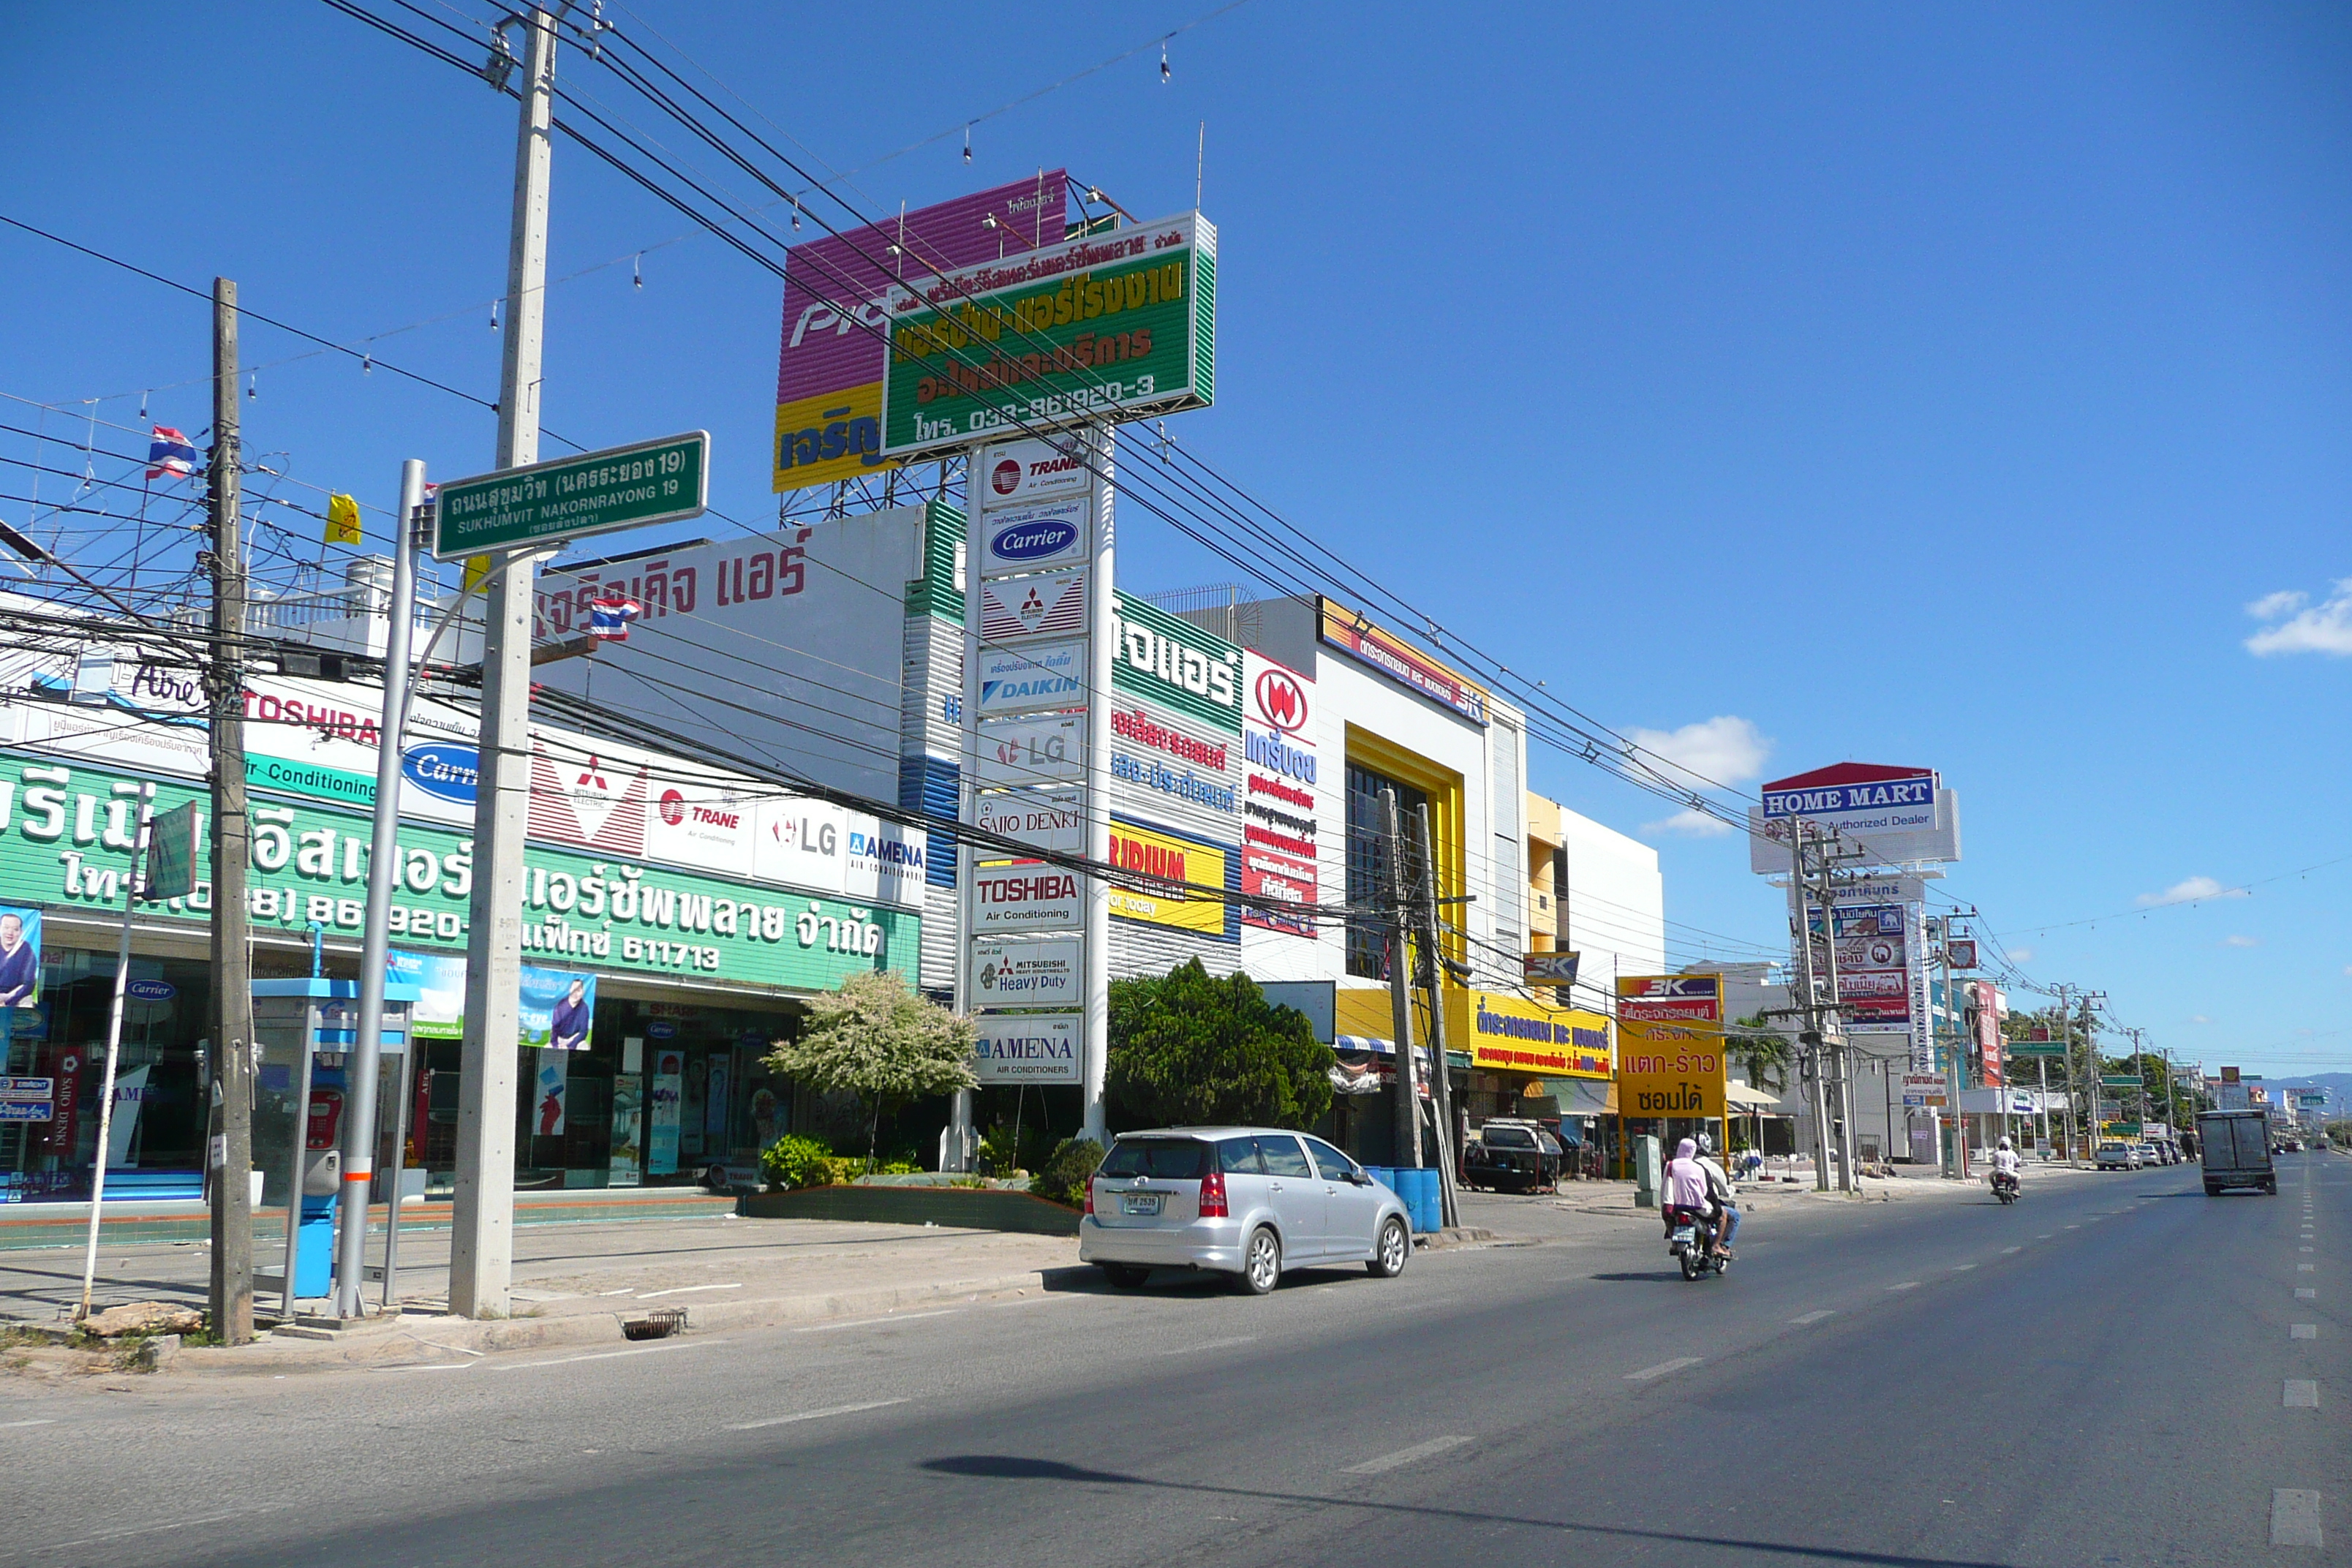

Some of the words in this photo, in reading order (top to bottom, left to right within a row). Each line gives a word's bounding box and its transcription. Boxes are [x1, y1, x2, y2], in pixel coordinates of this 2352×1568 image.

[969, 374, 1155, 431] 038-861920-3
[1029, 456, 1086, 477] TRANE
[451, 475, 548, 516] ถนนสุขุมวิท
[555, 459, 655, 497] (นครระยอง
[657, 449, 686, 475] 19)
[1028, 480, 1038, 489] Air
[1040, 475, 1077, 489] Conditioning
[457, 508, 535, 535] SUKHUMVIT
[540, 484, 657, 519] NAKORNRAYONG
[662, 479, 679, 496] 19
[1003, 529, 1067, 551] Carrier
[717, 527, 813, 608] แอร์
[1001, 675, 1079, 699] DAIKIN
[241, 690, 378, 745] TOSHIBA
[1029, 734, 1064, 766] LG
[1245, 727, 1317, 785] แครี่บอย
[268, 763, 377, 802] Conditioning
[573, 797, 605, 809] ELECTRIC
[1766, 791, 1843, 814] HOME
[1848, 782, 1929, 807] MART
[693, 806, 740, 829] TRANE
[979, 815, 1020, 834] SAIJO
[1026, 810, 1079, 831] DENKI
[1828, 816, 1888, 831] Authorized
[1891, 814, 1930, 826] Dealer
[687, 829, 697, 837] Air
[698, 832, 736, 846] Conditioning
[801, 817, 837, 857] LG
[864, 836, 924, 869] AMENA
[851, 859, 864, 870] AIR
[869, 863, 922, 882] CONDITIONERS
[977, 875, 1077, 904] TOSHIBA
[986, 911, 1000, 921] Air
[1003, 908, 1069, 920] Conditioning
[1125, 896, 1156, 917] today
[796, 901, 884, 956] จำกัด
[622, 937, 720, 970] 611713
[1015, 960, 1066, 969] MITSUBISHI
[131, 982, 171, 997] Carrier
[999, 976, 1039, 992] Heavy
[1041, 976, 1067, 989] Duty
[1643, 978, 1689, 996] 3K
[991, 1036, 1074, 1060] AMENA
[996, 1066, 1010, 1074] AIR
[1011, 1066, 1069, 1074] CONDITIONERS
[1624, 1047, 1717, 1074] แตก-ร้าว
[59, 1077, 72, 1107] SAIJO
[1637, 1082, 1703, 1111] ซ่อมได้
[55, 1111, 69, 1147] DENKI
[1139, 1196, 1156, 1206] 2535
